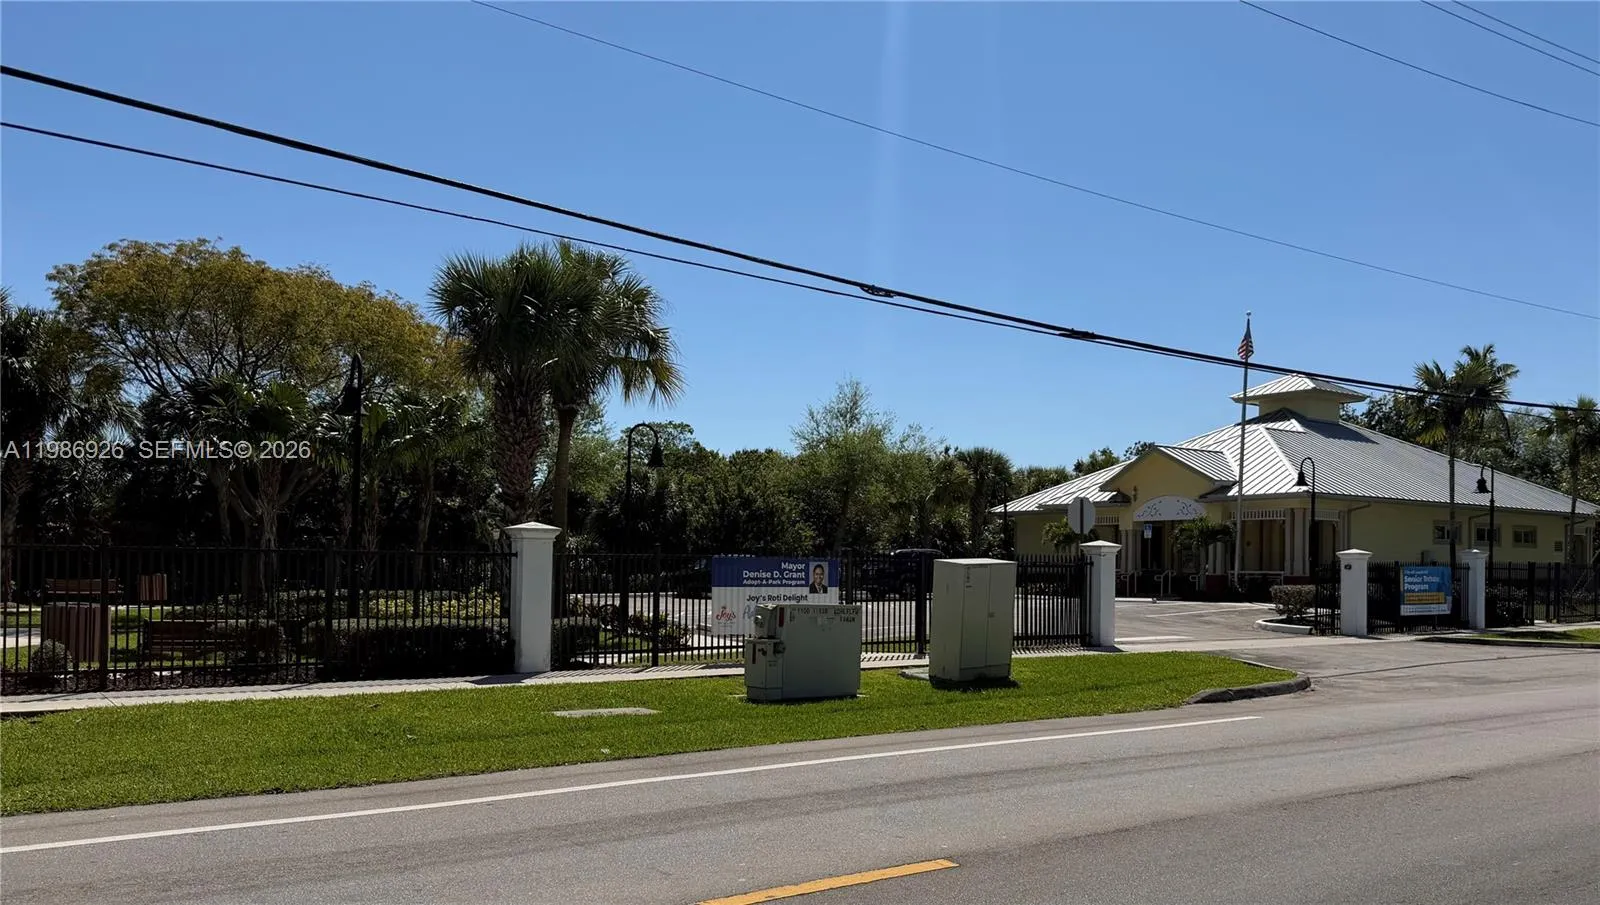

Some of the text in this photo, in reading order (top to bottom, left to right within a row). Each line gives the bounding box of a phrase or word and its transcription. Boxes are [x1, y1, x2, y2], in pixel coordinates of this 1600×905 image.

[781, 562, 806, 571] Mayor
[742, 570, 772, 578] Denise
[784, 570, 806, 579] Grant
[1404, 575, 1423, 583] Senior
[1404, 583, 1429, 591] Program
[746, 594, 767, 603] Joy's
[783, 594, 808, 603] Delight
